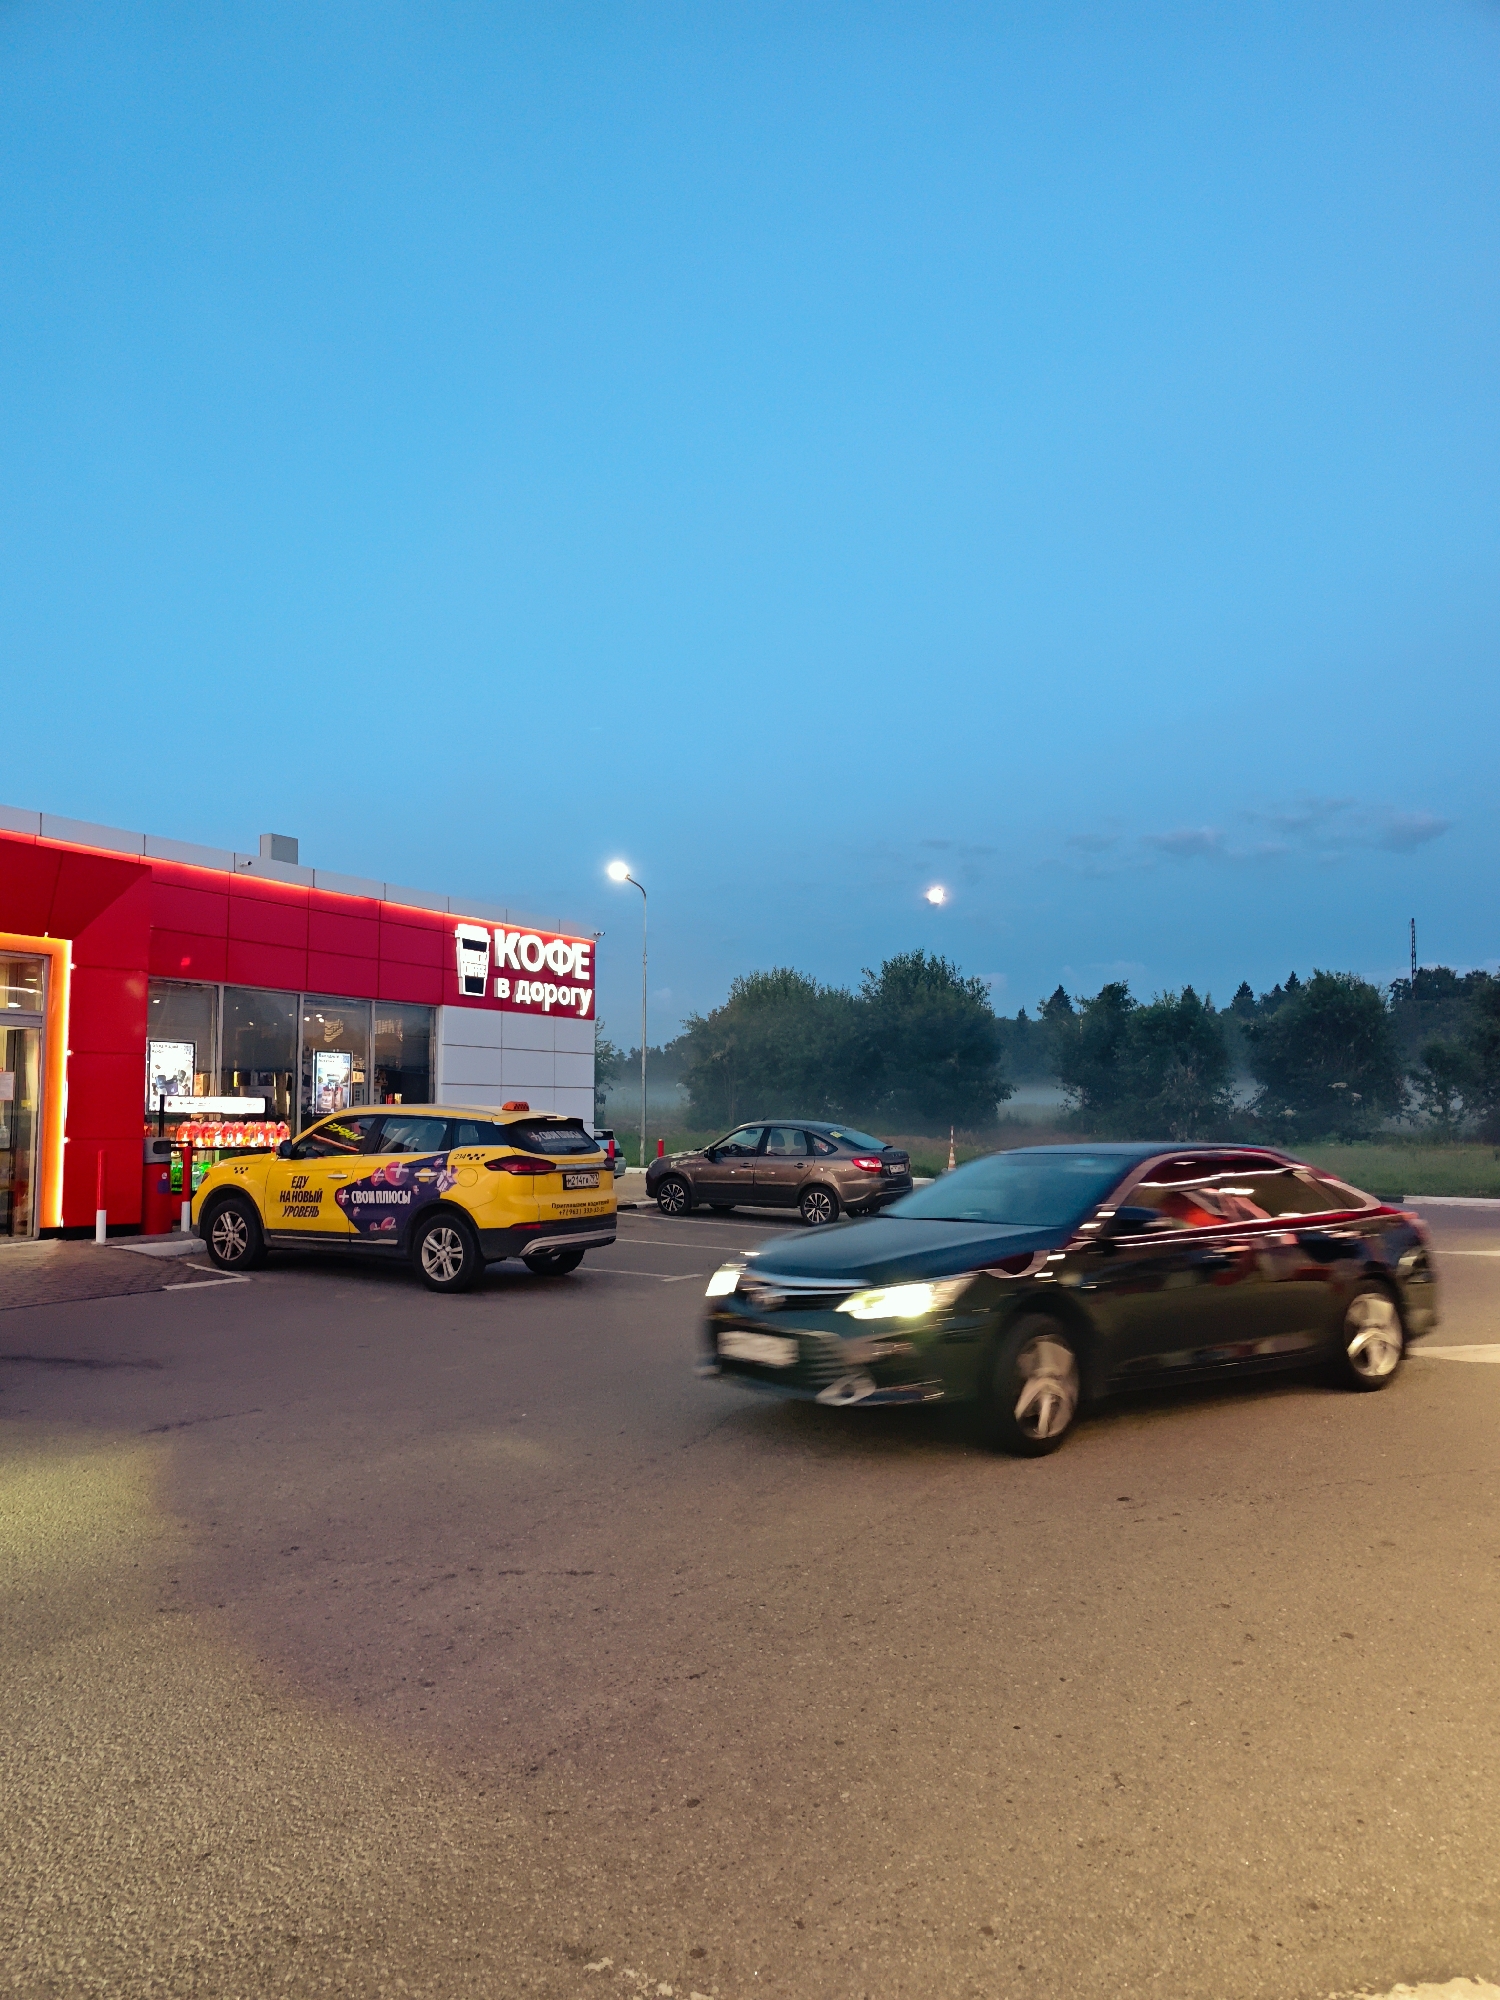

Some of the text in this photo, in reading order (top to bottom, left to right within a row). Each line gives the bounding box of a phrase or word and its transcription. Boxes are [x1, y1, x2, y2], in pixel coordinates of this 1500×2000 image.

[493, 928, 590, 980] КОФЕ
[495, 977, 593, 1016] в дорогу
[291, 1175, 310, 1189] ЕДУ
[279, 1188, 323, 1203] НА НОВЫЙ
[351, 1190, 412, 1205] СВОИ ПЛЮСЫ
[282, 1205, 320, 1218] УРОВЕНЬ
